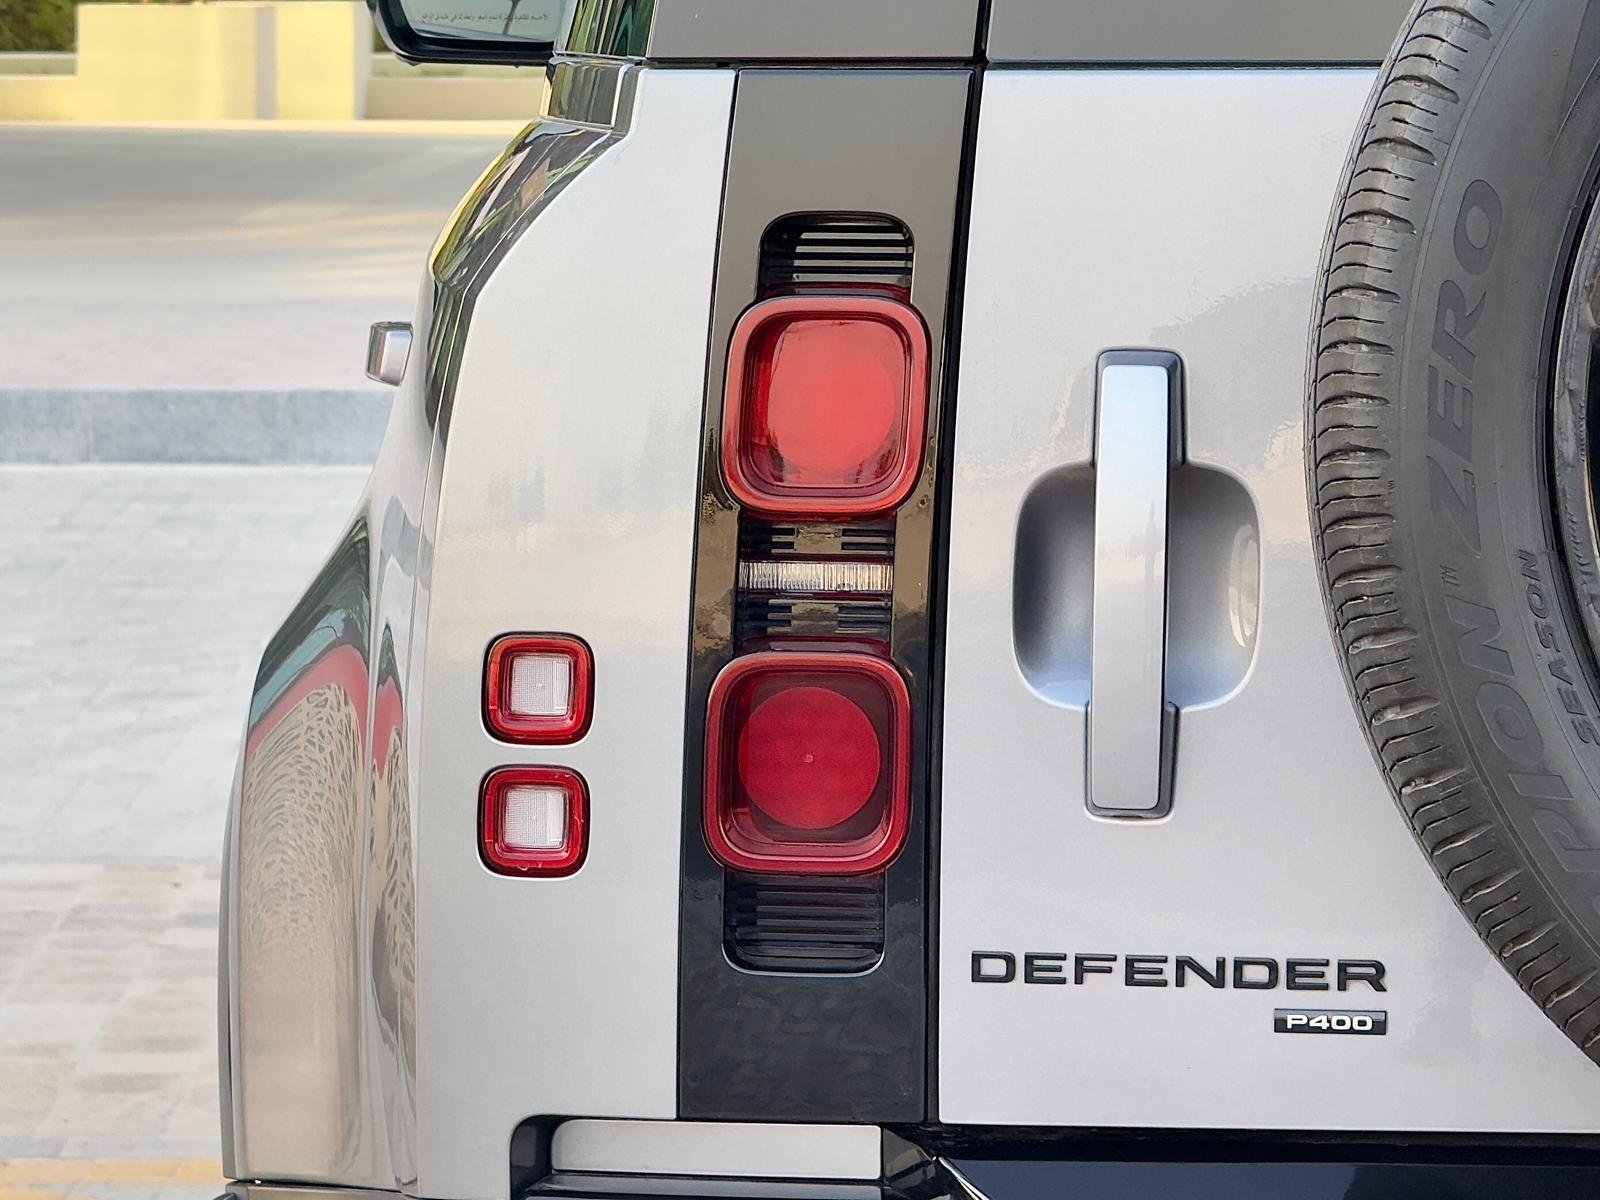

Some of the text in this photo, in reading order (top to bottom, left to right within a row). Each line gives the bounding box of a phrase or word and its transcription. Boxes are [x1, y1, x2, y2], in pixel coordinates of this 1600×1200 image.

[1427, 179, 1502, 558] ZERO
[1518, 549, 1600, 747] SEASON
[1444, 594, 1600, 914] PION
[971, 950, 1387, 992] DEFENDER
[1286, 1013, 1374, 1031] P400
